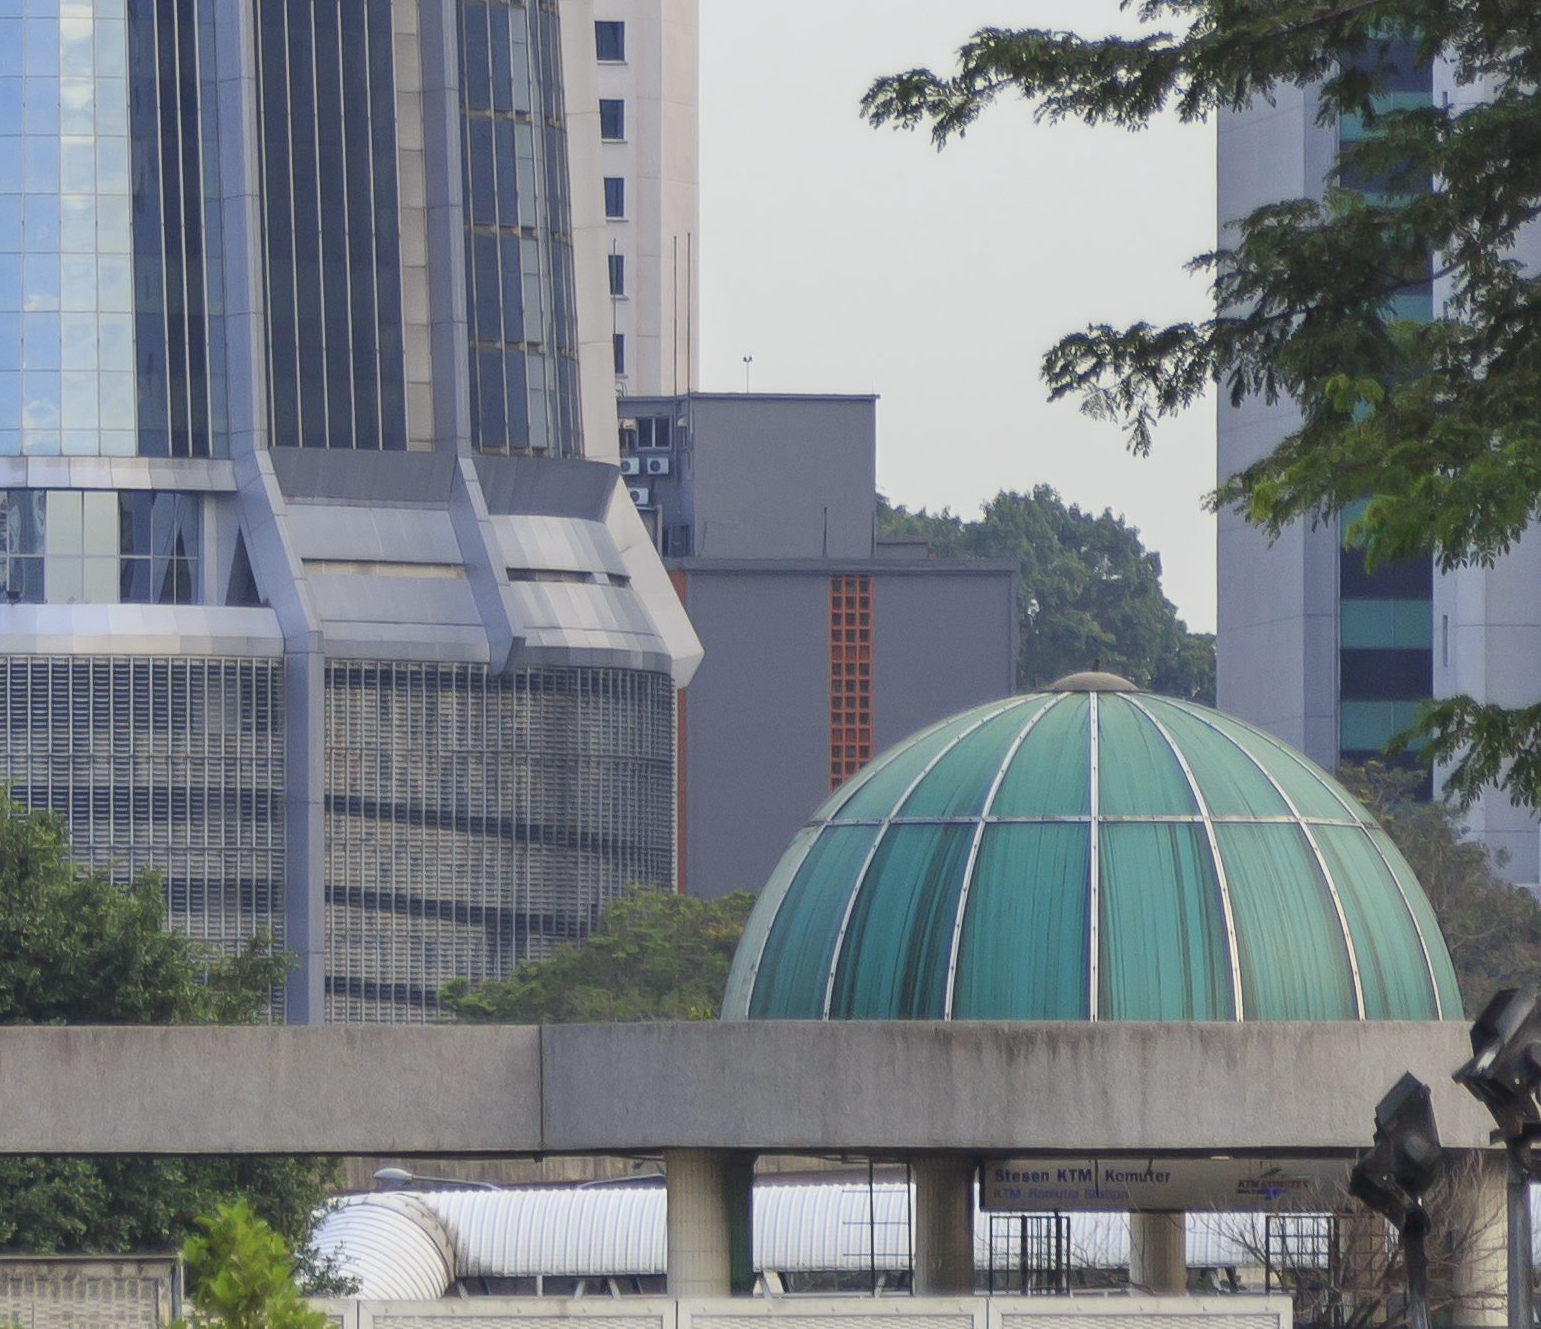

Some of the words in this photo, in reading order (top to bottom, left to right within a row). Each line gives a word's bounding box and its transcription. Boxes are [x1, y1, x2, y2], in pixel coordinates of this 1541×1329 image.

[994, 1168, 1050, 1183] Stesen
[1056, 1168, 1093, 1183] KTM
[1104, 1168, 1172, 1184] Komuter
[993, 1188, 1021, 1199] KTM
